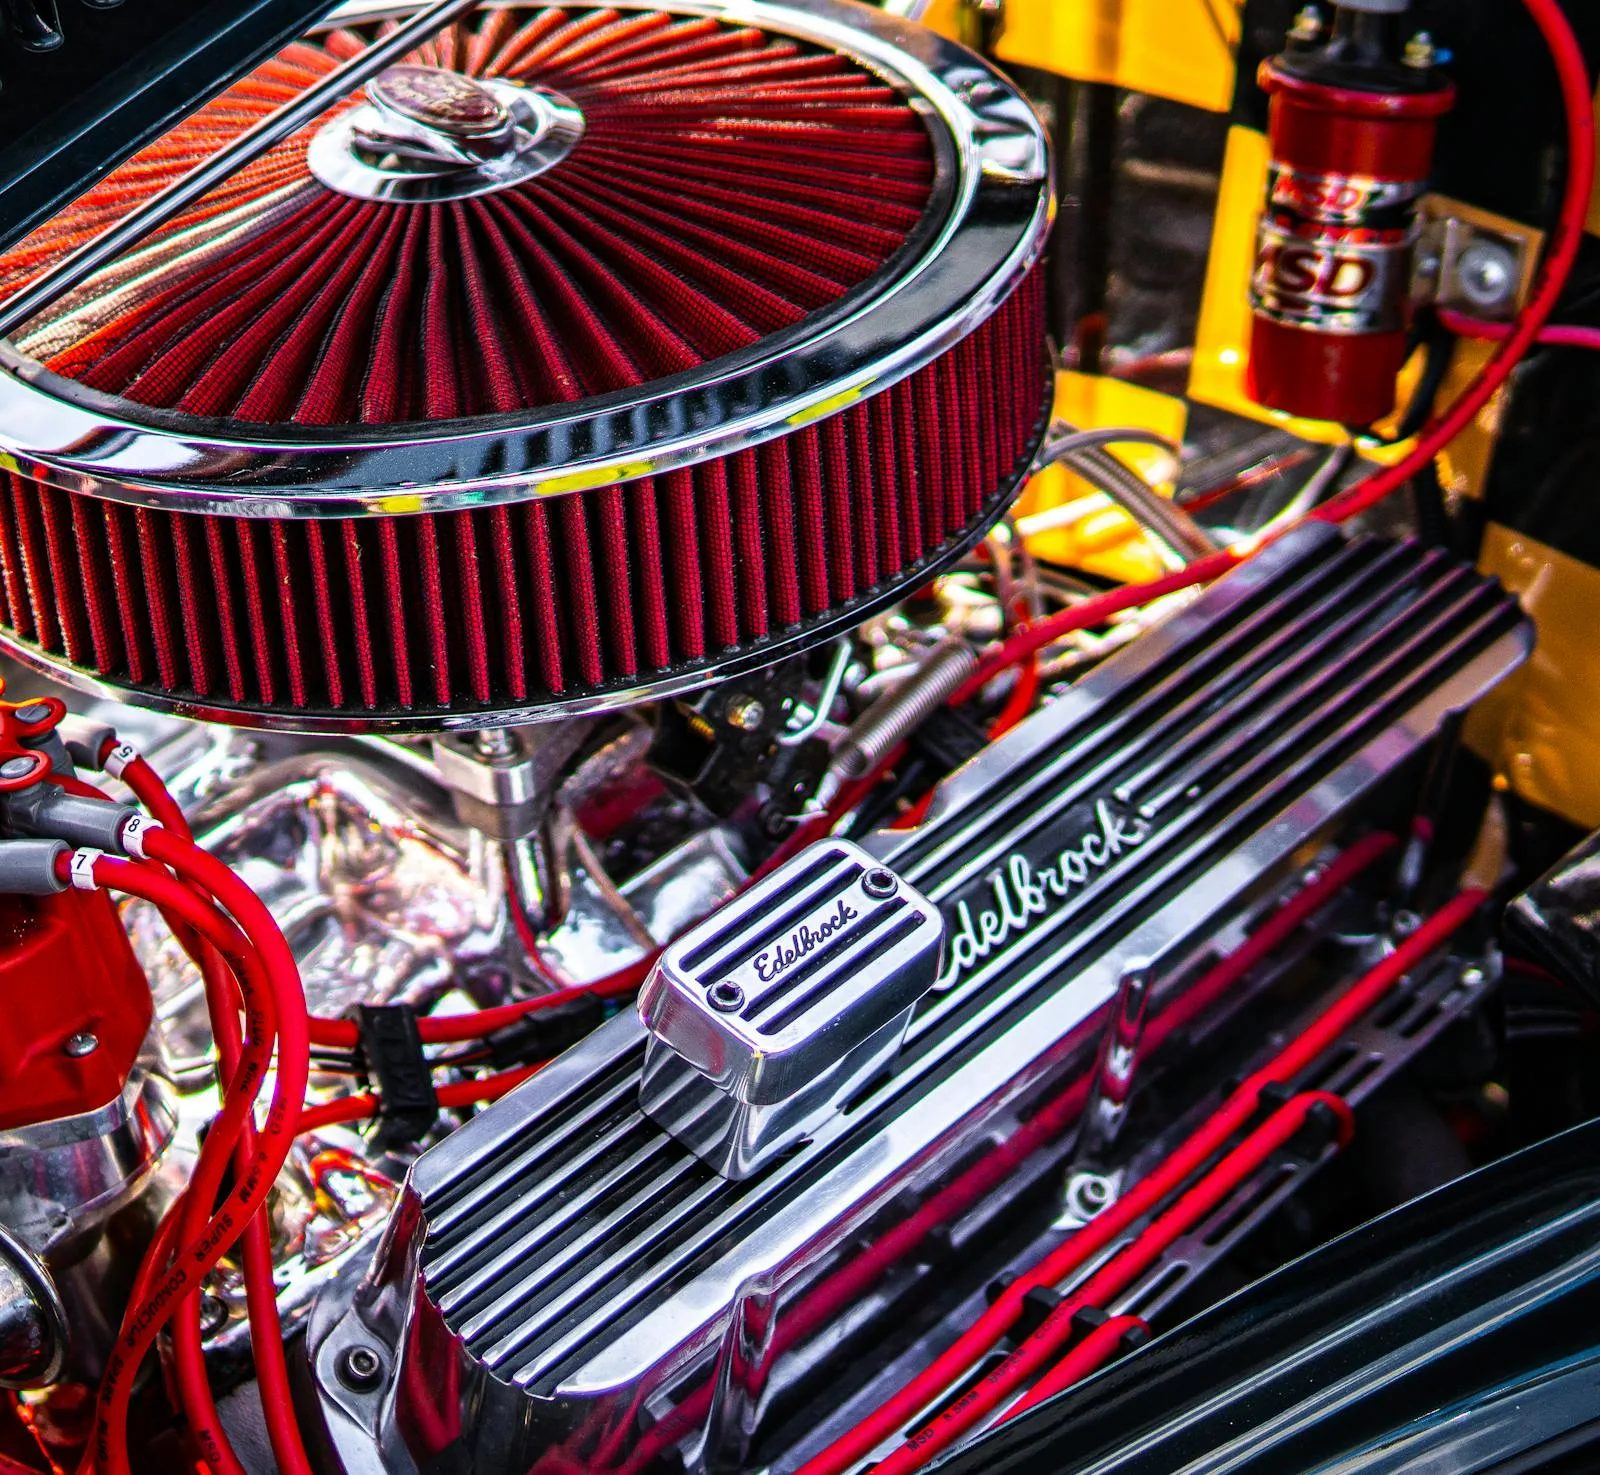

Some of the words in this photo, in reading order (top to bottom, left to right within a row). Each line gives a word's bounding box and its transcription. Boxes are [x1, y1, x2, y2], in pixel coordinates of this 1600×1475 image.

[128, 818, 141, 833] 8
[74, 853, 87, 870] 7
[931, 798, 1148, 990] delbrock
[752, 899, 858, 982] Edelbrock
[194, 1213, 233, 1262] SUPER
[905, 1427, 935, 1452] MSD
